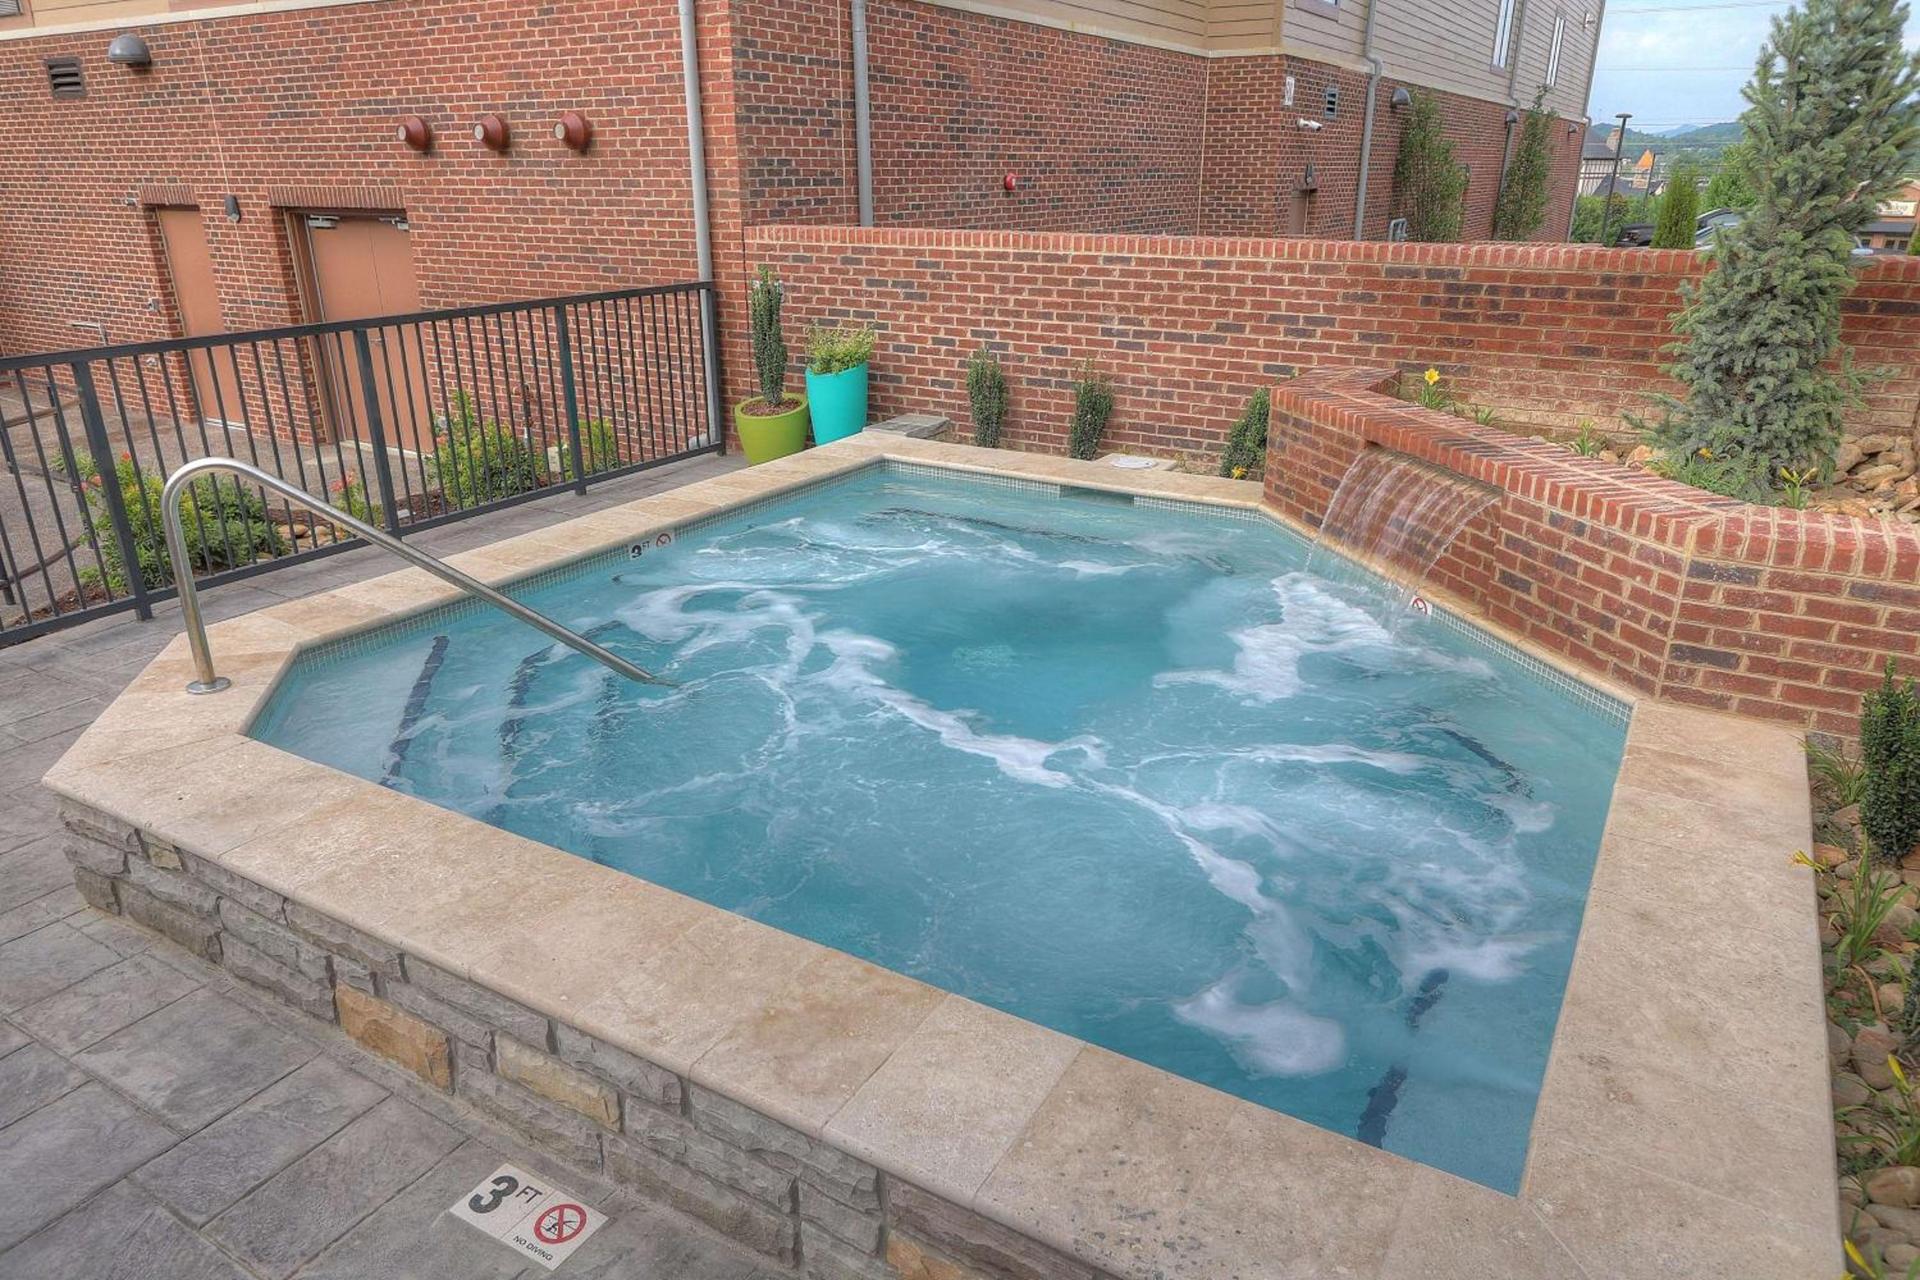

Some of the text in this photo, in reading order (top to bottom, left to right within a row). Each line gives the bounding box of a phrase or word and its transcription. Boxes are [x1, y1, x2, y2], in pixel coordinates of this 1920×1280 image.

[468, 1175, 543, 1214] 3 FT
[513, 1235, 554, 1261] NO DIVING
